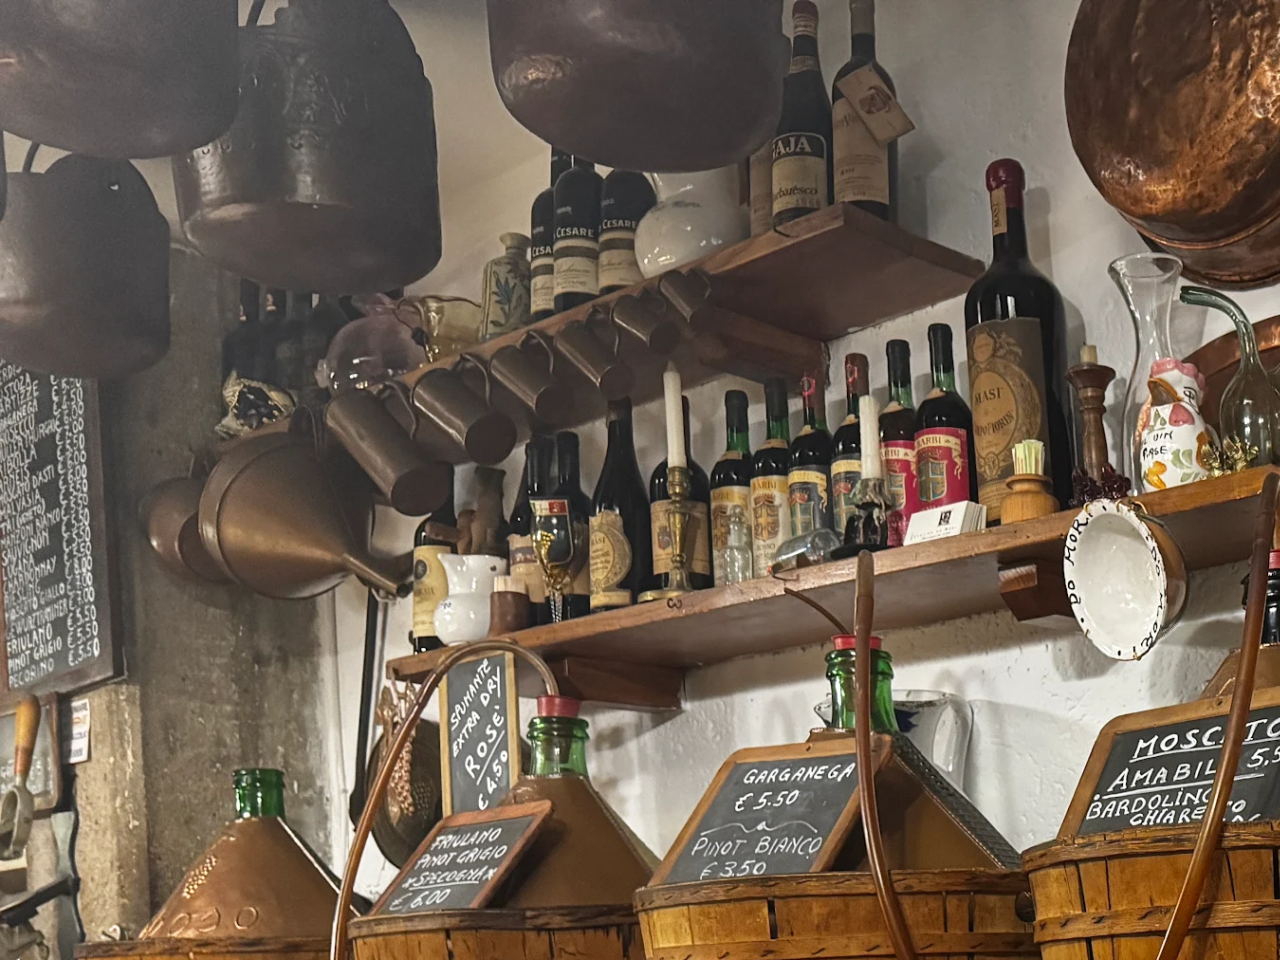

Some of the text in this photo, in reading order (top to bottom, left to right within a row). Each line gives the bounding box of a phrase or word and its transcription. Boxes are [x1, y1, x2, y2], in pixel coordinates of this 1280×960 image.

[556, 226, 595, 239] CESARE
[602, 219, 638, 230] CESARE
[532, 245, 553, 257] CESA
[974, 386, 1002, 407] MASI
[916, 434, 942, 448] BARBI
[6, 622, 53, 657] FRIULANO
[8, 649, 31, 675] PINOT
[33, 636, 63, 660] GRIGIO
[9, 658, 54, 689] PECORINO
[450, 658, 493, 731] SPUMANTE
[452, 666, 502, 758] EXTRA DRY
[743, 762, 856, 785] GARGANEGA
[1106, 758, 1218, 793] AMABIL
[734, 789, 800, 812] € 5.50
[430, 826, 503, 852] FRIULANO
[690, 835, 823, 857] PINOT BIANCO
[414, 844, 508, 872] PINOT GRIGIO
[409, 888, 452, 909] 6.00
